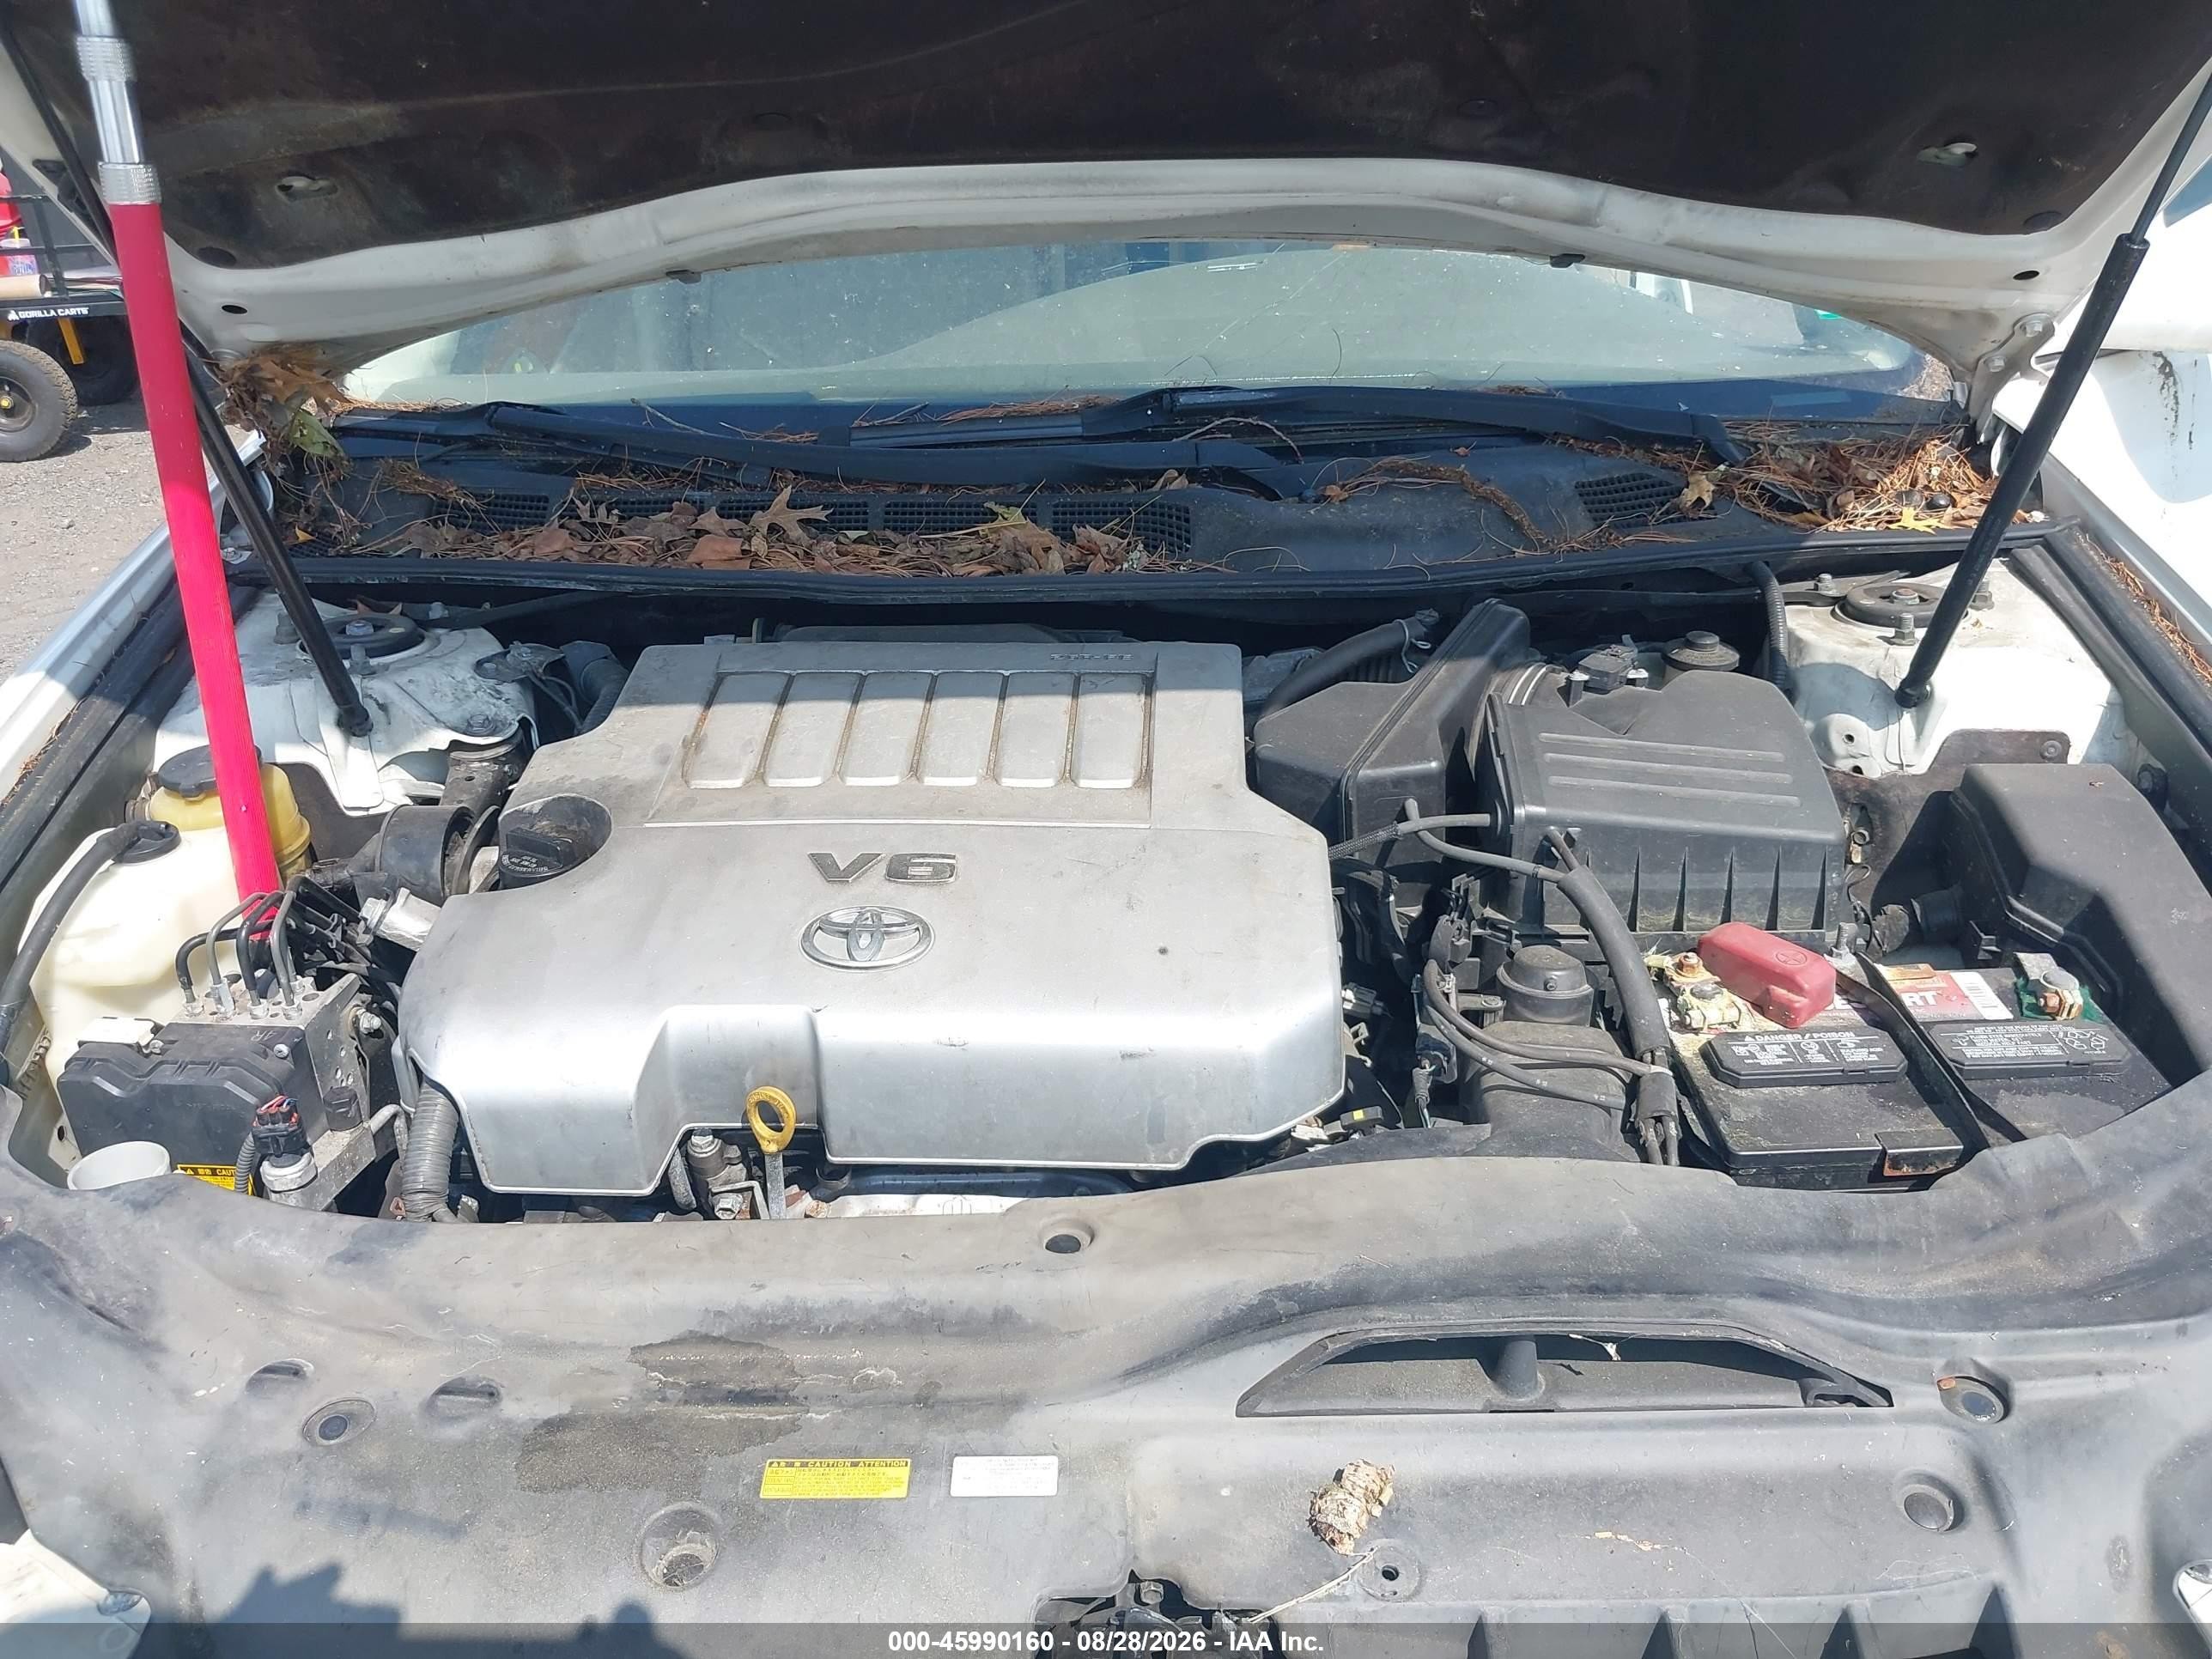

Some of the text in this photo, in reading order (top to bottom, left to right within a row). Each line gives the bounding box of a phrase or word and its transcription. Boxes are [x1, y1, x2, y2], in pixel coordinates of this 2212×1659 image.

[18, 307, 88, 319] GORILLA CARTS
[807, 852, 957, 883] V6
